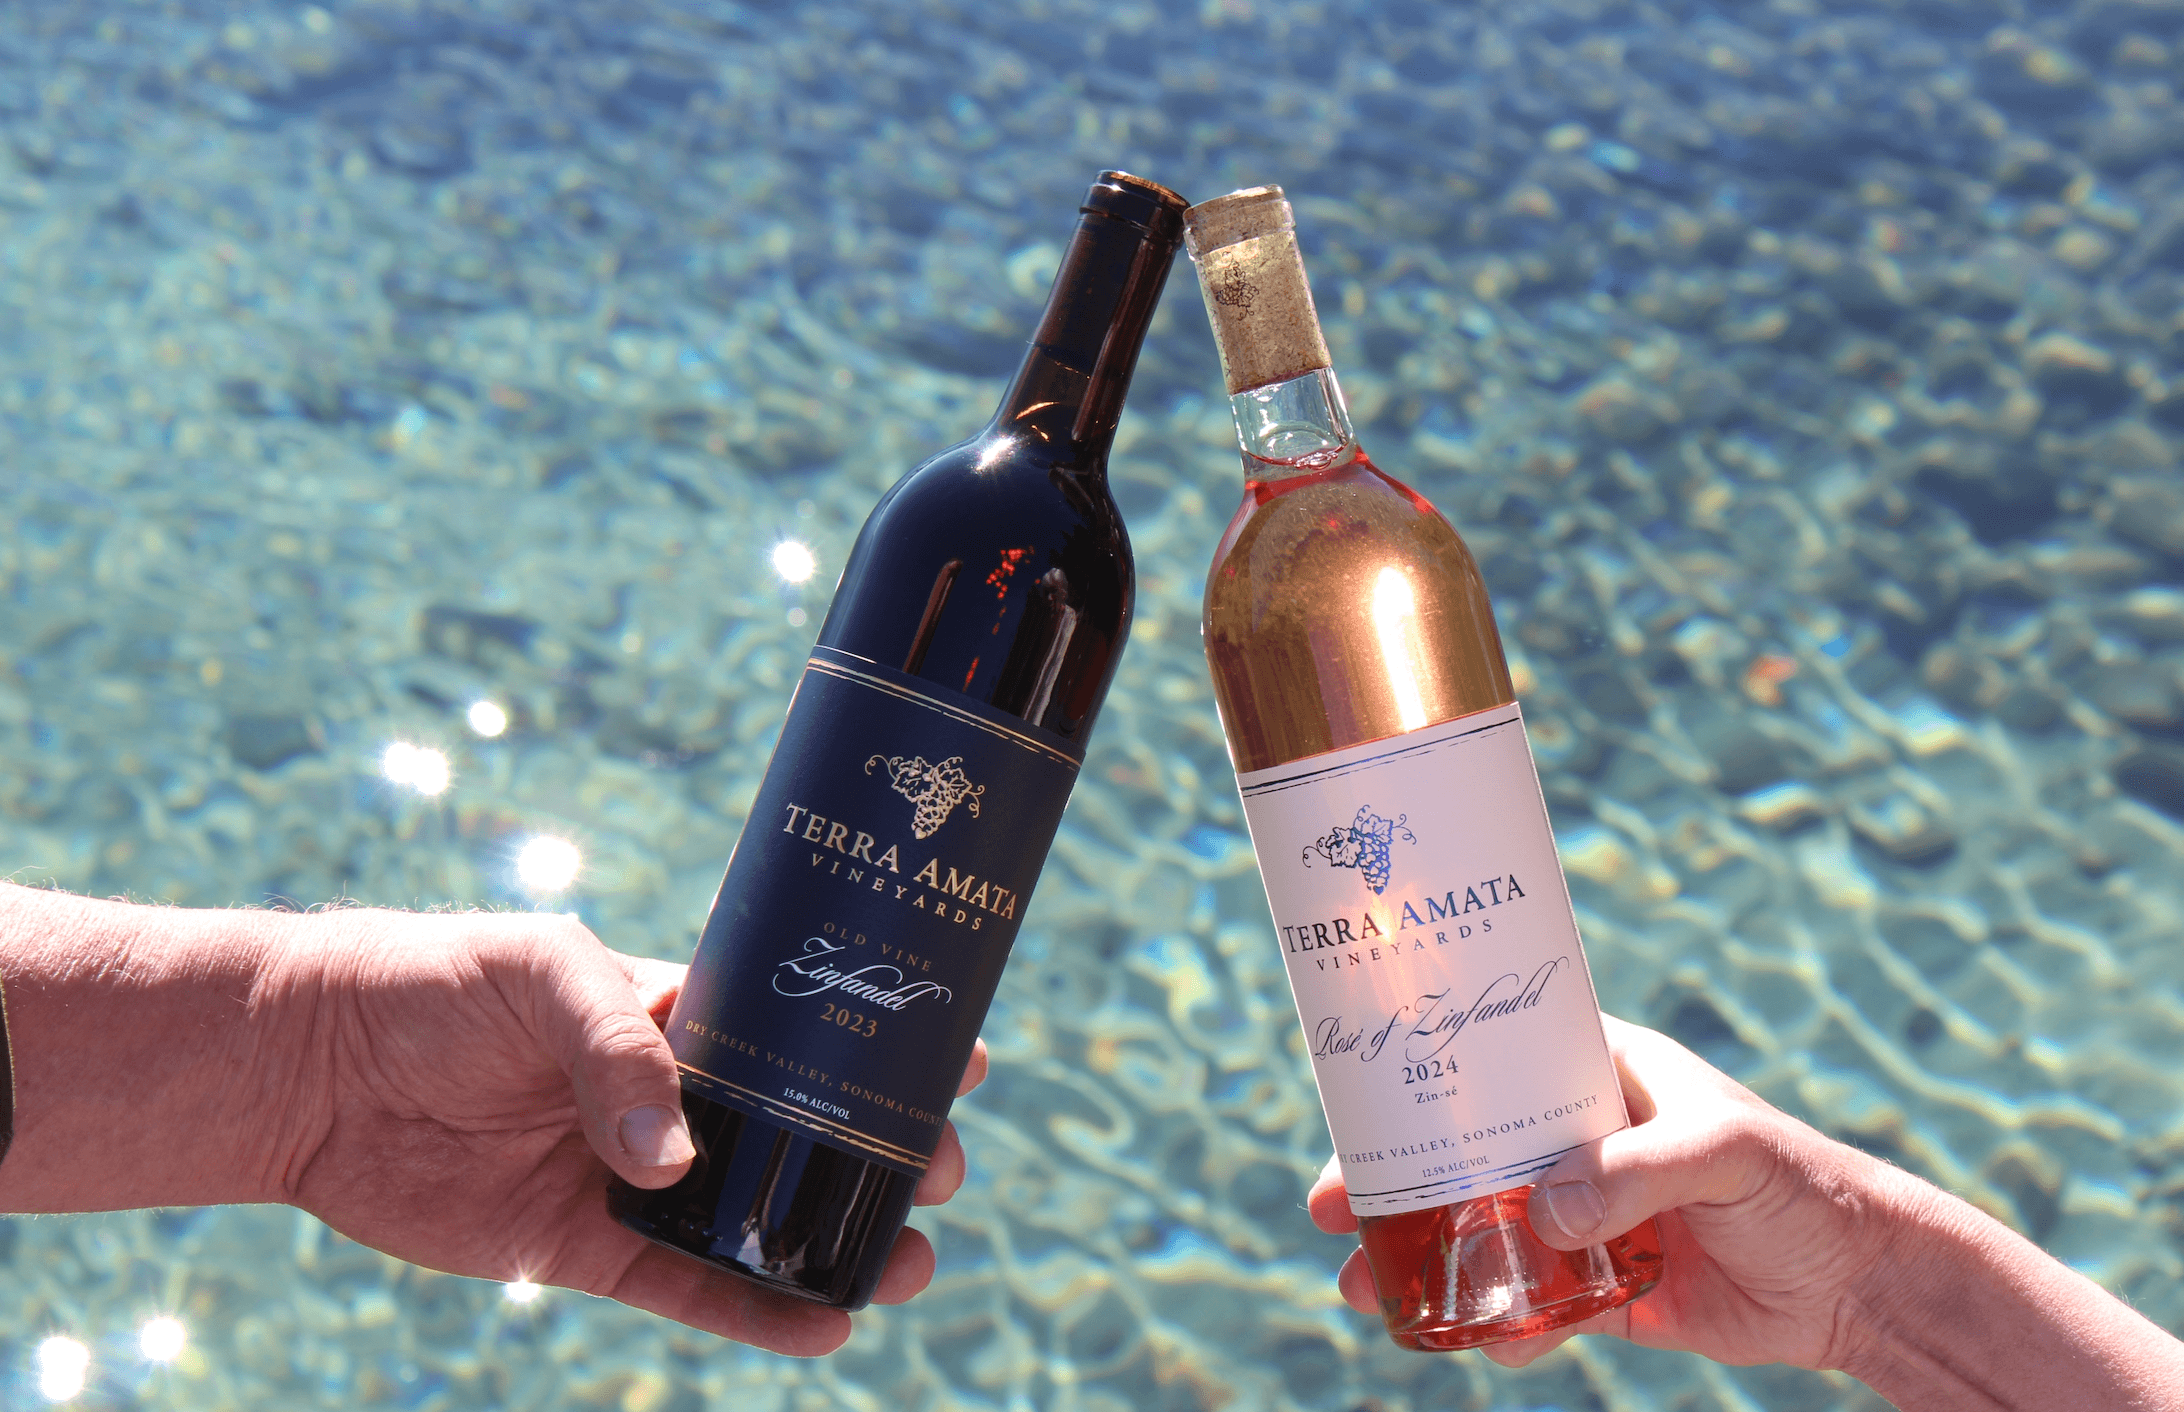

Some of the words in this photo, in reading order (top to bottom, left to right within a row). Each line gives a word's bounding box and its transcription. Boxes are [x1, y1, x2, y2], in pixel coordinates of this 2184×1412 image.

[783, 802, 900, 875] TERRA
[913, 857, 1019, 920] AMATA
[810, 853, 983, 931] VINEYARDS
[1282, 912, 1383, 953] TERRA
[1398, 873, 1526, 931] AMATA
[773, 937, 953, 1011] Zinfandel
[824, 922, 867, 946] OLD
[882, 943, 933, 972] VINE
[1316, 919, 1493, 972] VINEYARDS
[820, 1003, 879, 1039] 2023
[1314, 1016, 1362, 1061] Rosé
[1361, 1006, 1409, 1062] of
[1404, 956, 1570, 1064] Zinfandel
[685, 1020, 708, 1036] DRY
[711, 1031, 759, 1057] CREEK
[766, 1051, 833, 1088] VALLEY,
[840, 1081, 904, 1113] SONOMA
[1401, 1055, 1460, 1085] 2024
[1414, 1087, 1459, 1105] Zin-sé
[783, 1087, 809, 1104] 15.0%
[809, 1097, 850, 1120] ALC/VOL
[1349, 1150, 1385, 1164] CREEK
[1389, 1137, 1456, 1159] VALLEY,
[1462, 1116, 1537, 1144] SONOMA
[1543, 1094, 1599, 1122] COUNTY
[1422, 1165, 1446, 1179] 12.5%
[1448, 1155, 1490, 1174] ALC/VOL
